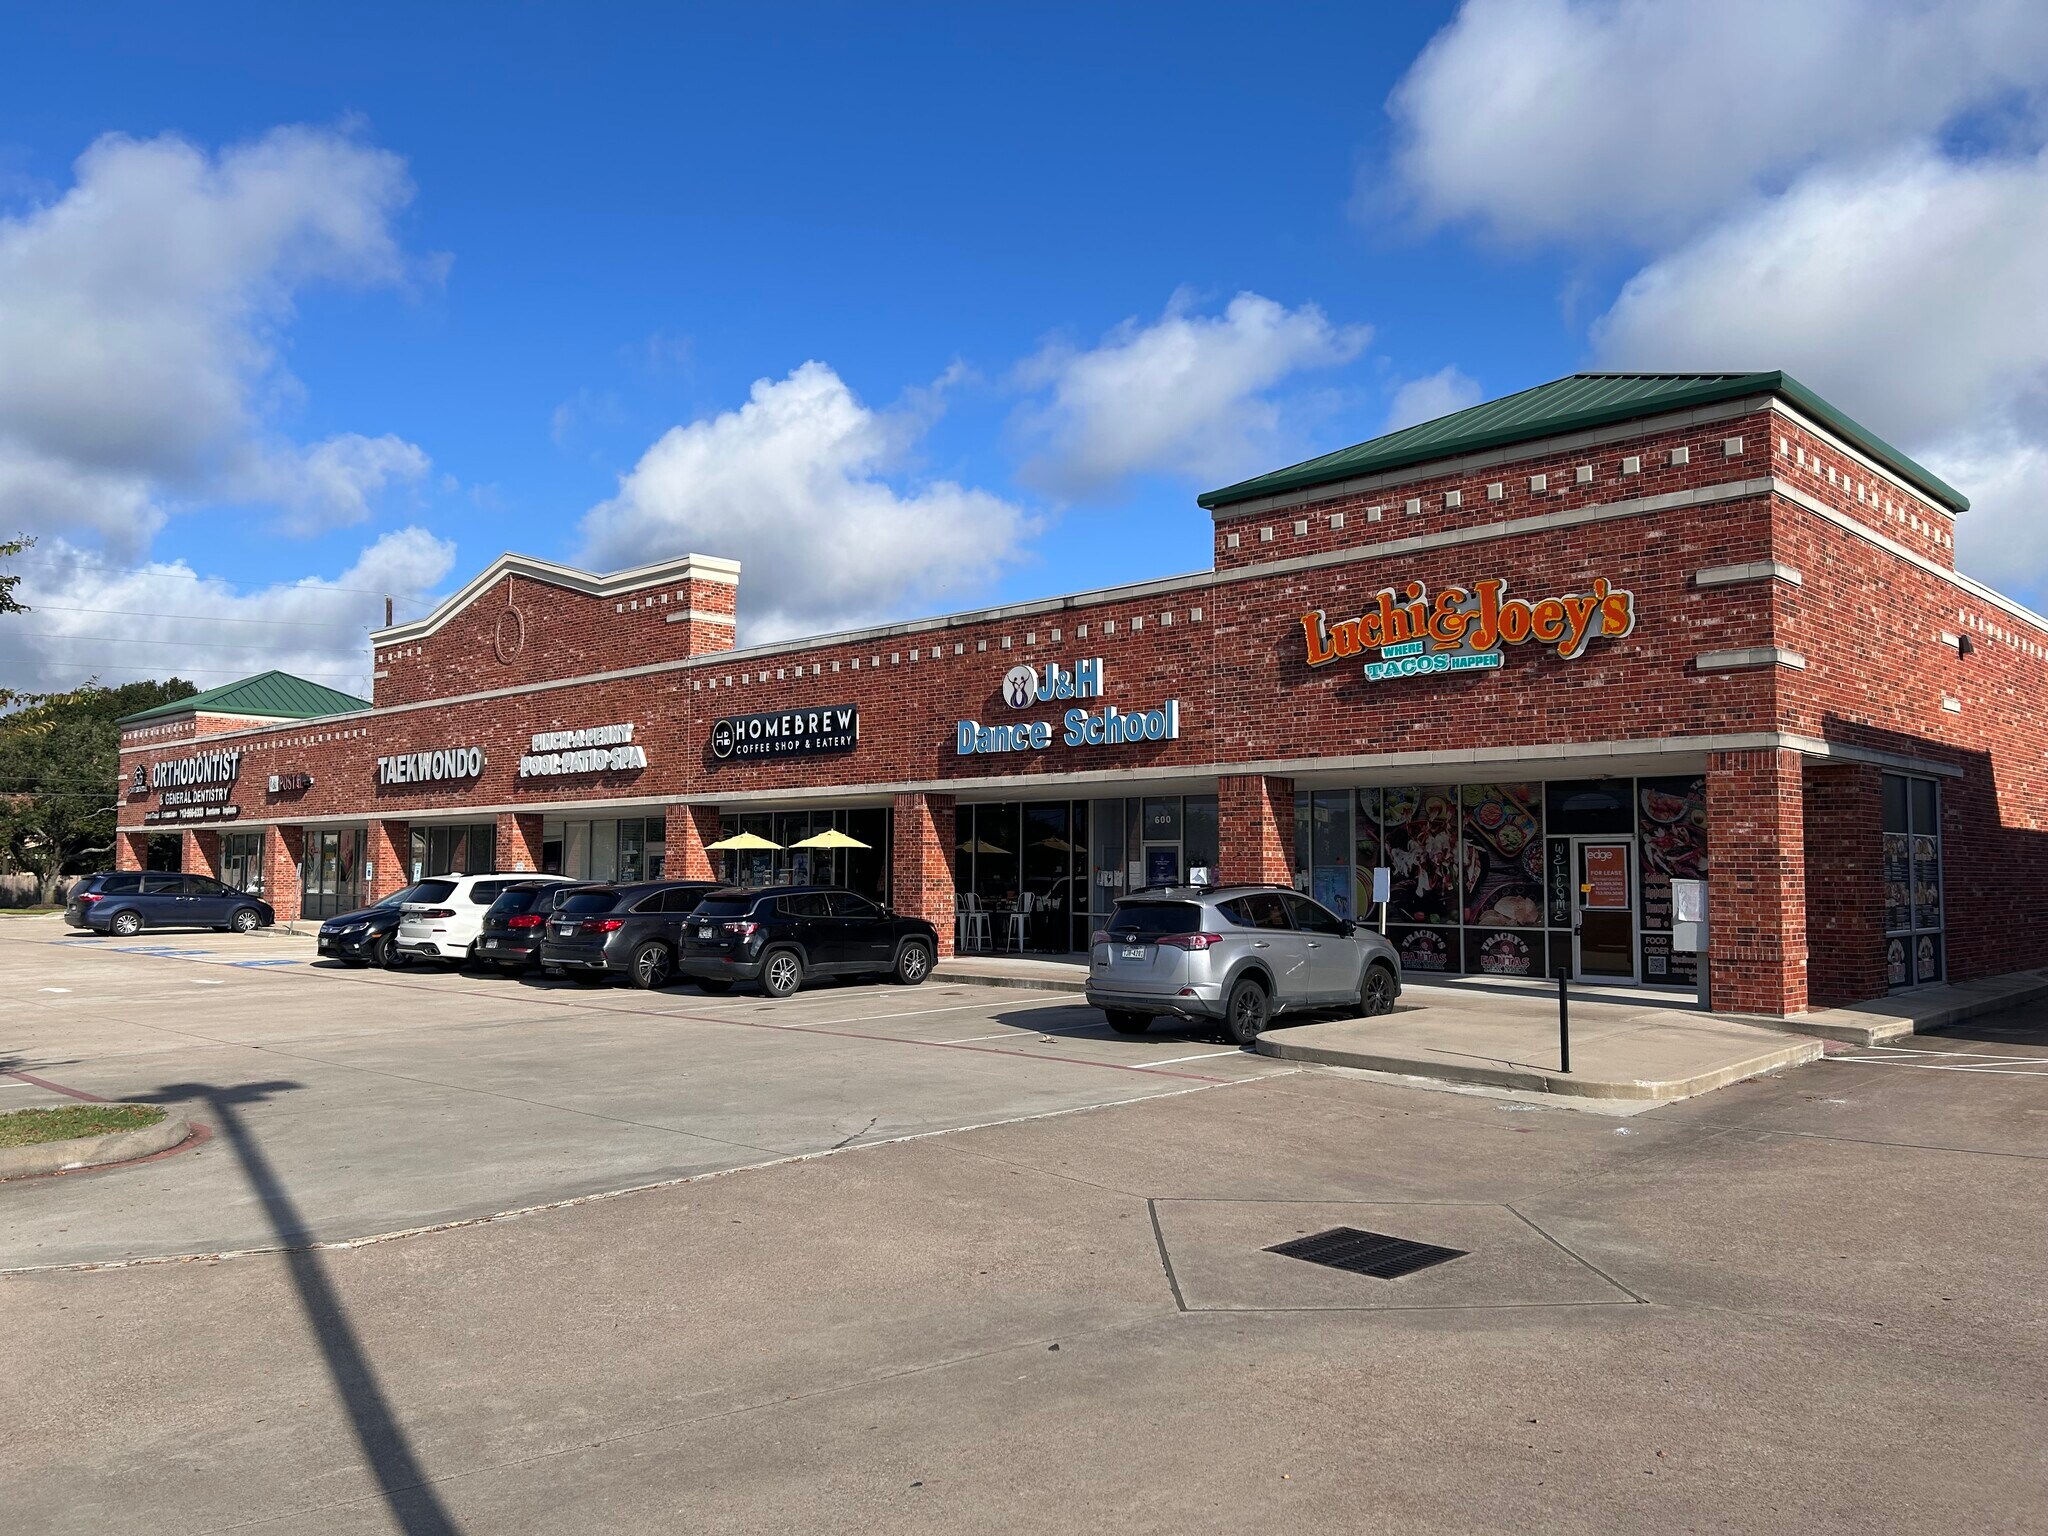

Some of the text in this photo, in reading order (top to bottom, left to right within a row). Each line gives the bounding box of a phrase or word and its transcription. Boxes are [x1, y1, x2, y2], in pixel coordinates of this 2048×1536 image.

[1470, 578, 1630, 657] Joey's
[1383, 643, 1422, 657] WHERE
[1366, 654, 1498, 678] TACOS HAPPEN
[1037, 658, 1103, 701] J&H
[736, 709, 852, 740] HOMEBREW
[957, 700, 1178, 755] Dance School
[736, 736, 852, 754] COFFEE SHOP & EATERY
[152, 752, 239, 788] ORTHODONTIST
[378, 746, 482, 784] TAEKWONDO
[165, 790, 191, 805] GENERAL
[193, 787, 229, 803] DENTISTRY
[1154, 815, 1171, 824] 600
[1587, 849, 1613, 862] edge
[1401, 930, 1446, 950] TRACEY'S
[1481, 932, 1529, 953] TRACEY'S
[1646, 937, 1667, 945] FOOD
[1644, 946, 1669, 955] ORDER
